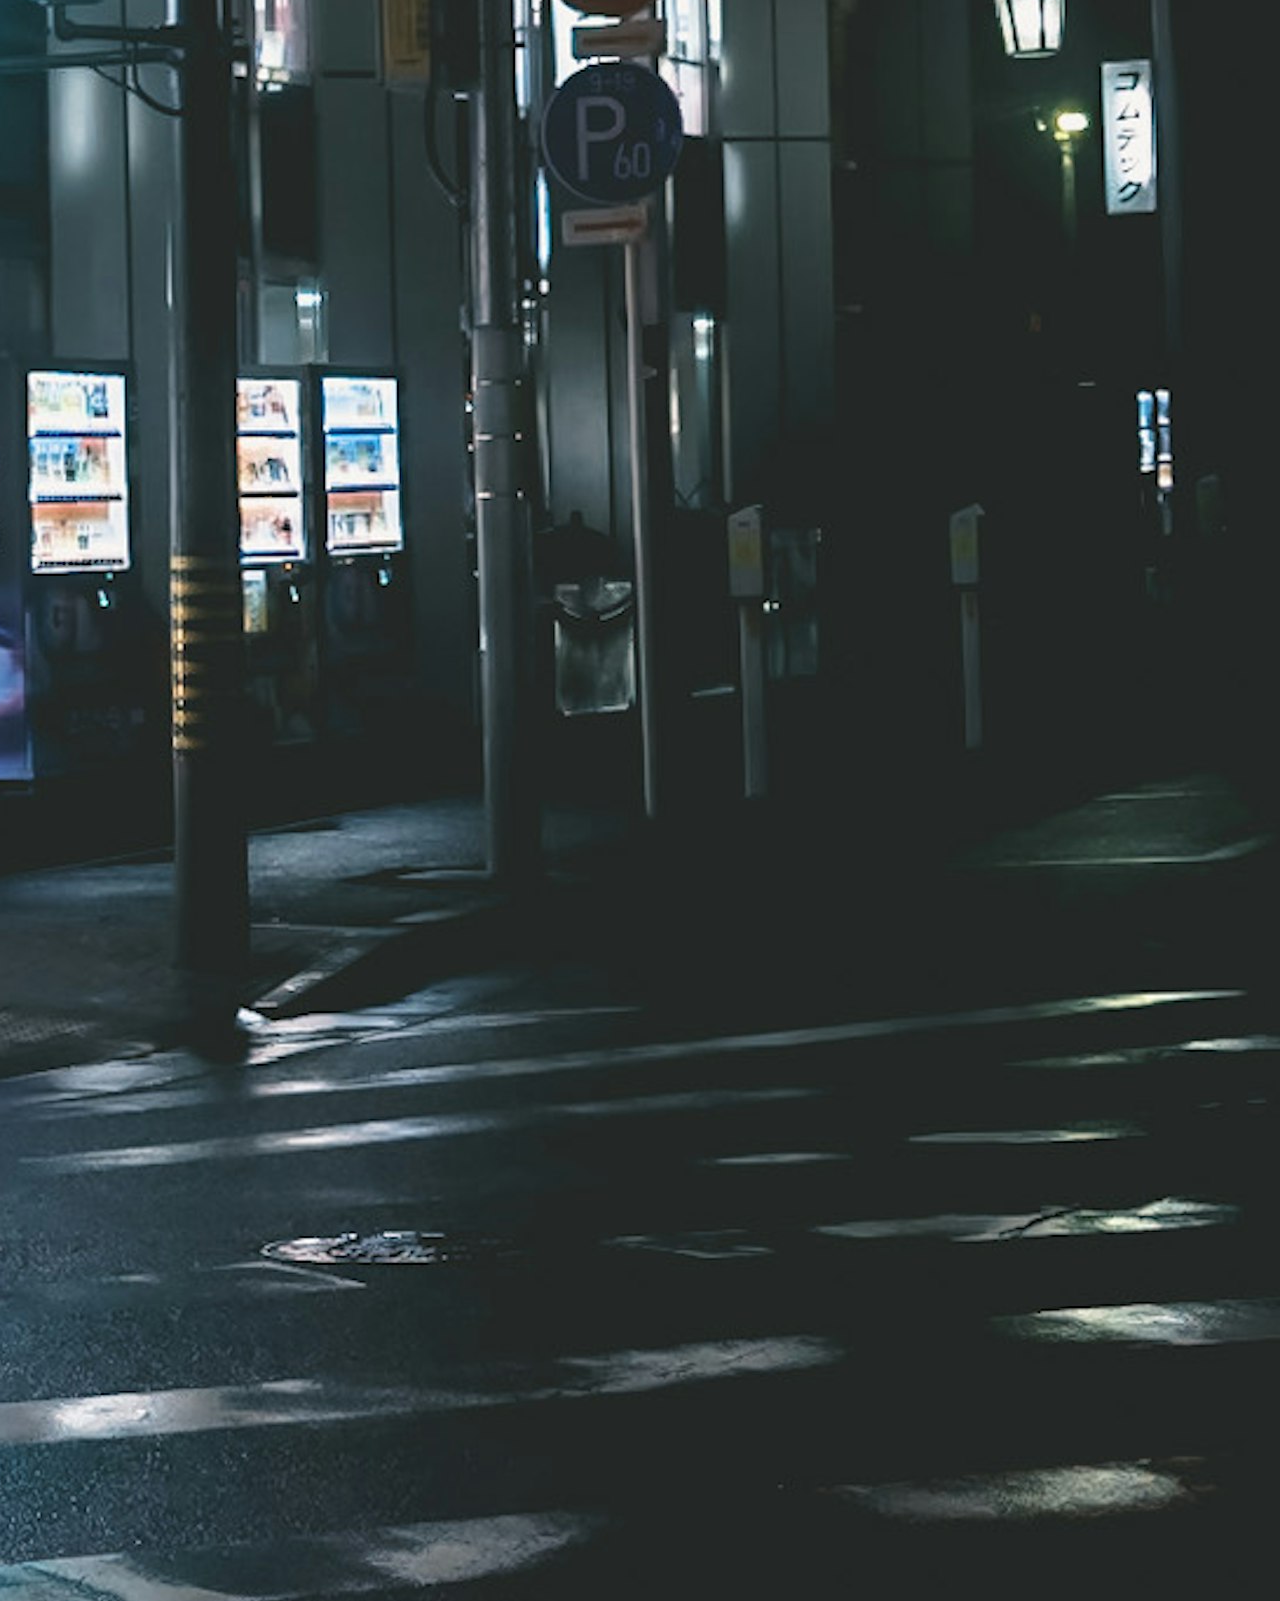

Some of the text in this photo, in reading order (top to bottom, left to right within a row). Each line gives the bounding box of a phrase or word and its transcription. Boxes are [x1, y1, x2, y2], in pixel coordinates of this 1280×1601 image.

[575, 96, 626, 181] P
[613, 143, 651, 180] 60
[1113, 71, 1143, 203] コムテック
